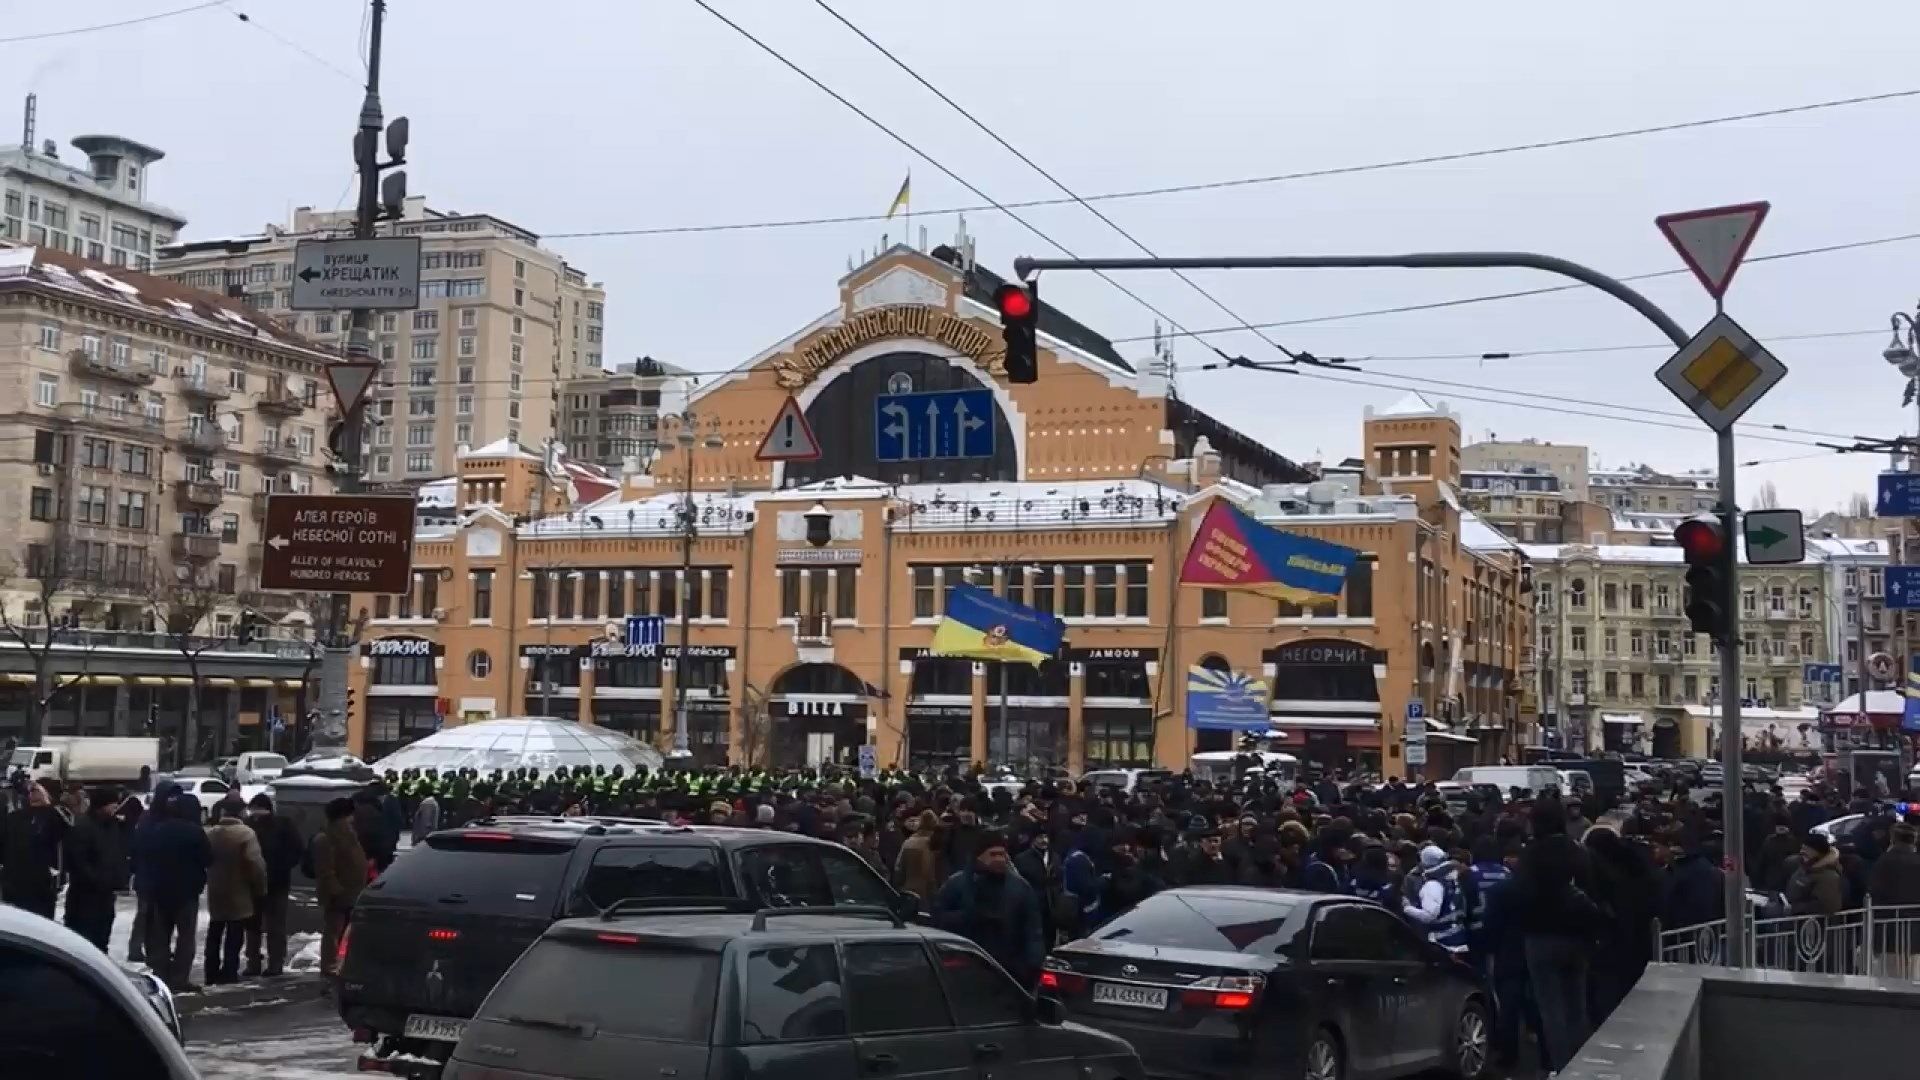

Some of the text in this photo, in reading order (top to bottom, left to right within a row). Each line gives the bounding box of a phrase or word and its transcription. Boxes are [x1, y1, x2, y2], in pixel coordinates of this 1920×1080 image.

[322, 265, 400, 282] ХРЕЩАТИК
[294, 508, 377, 524] АЛЕЯ ГЕРОЇВ
[292, 527, 397, 545] НЕБЕСНОЇ СОТНІ
[291, 555, 384, 568] ALLEY OF HEAVENLY
[290, 569, 370, 581] HUNDRED HEROES
[1089, 649, 1140, 658] JAMOON
[1282, 648, 1369, 663] НЕГОРЧИТ
[788, 701, 843, 715] BILLA
